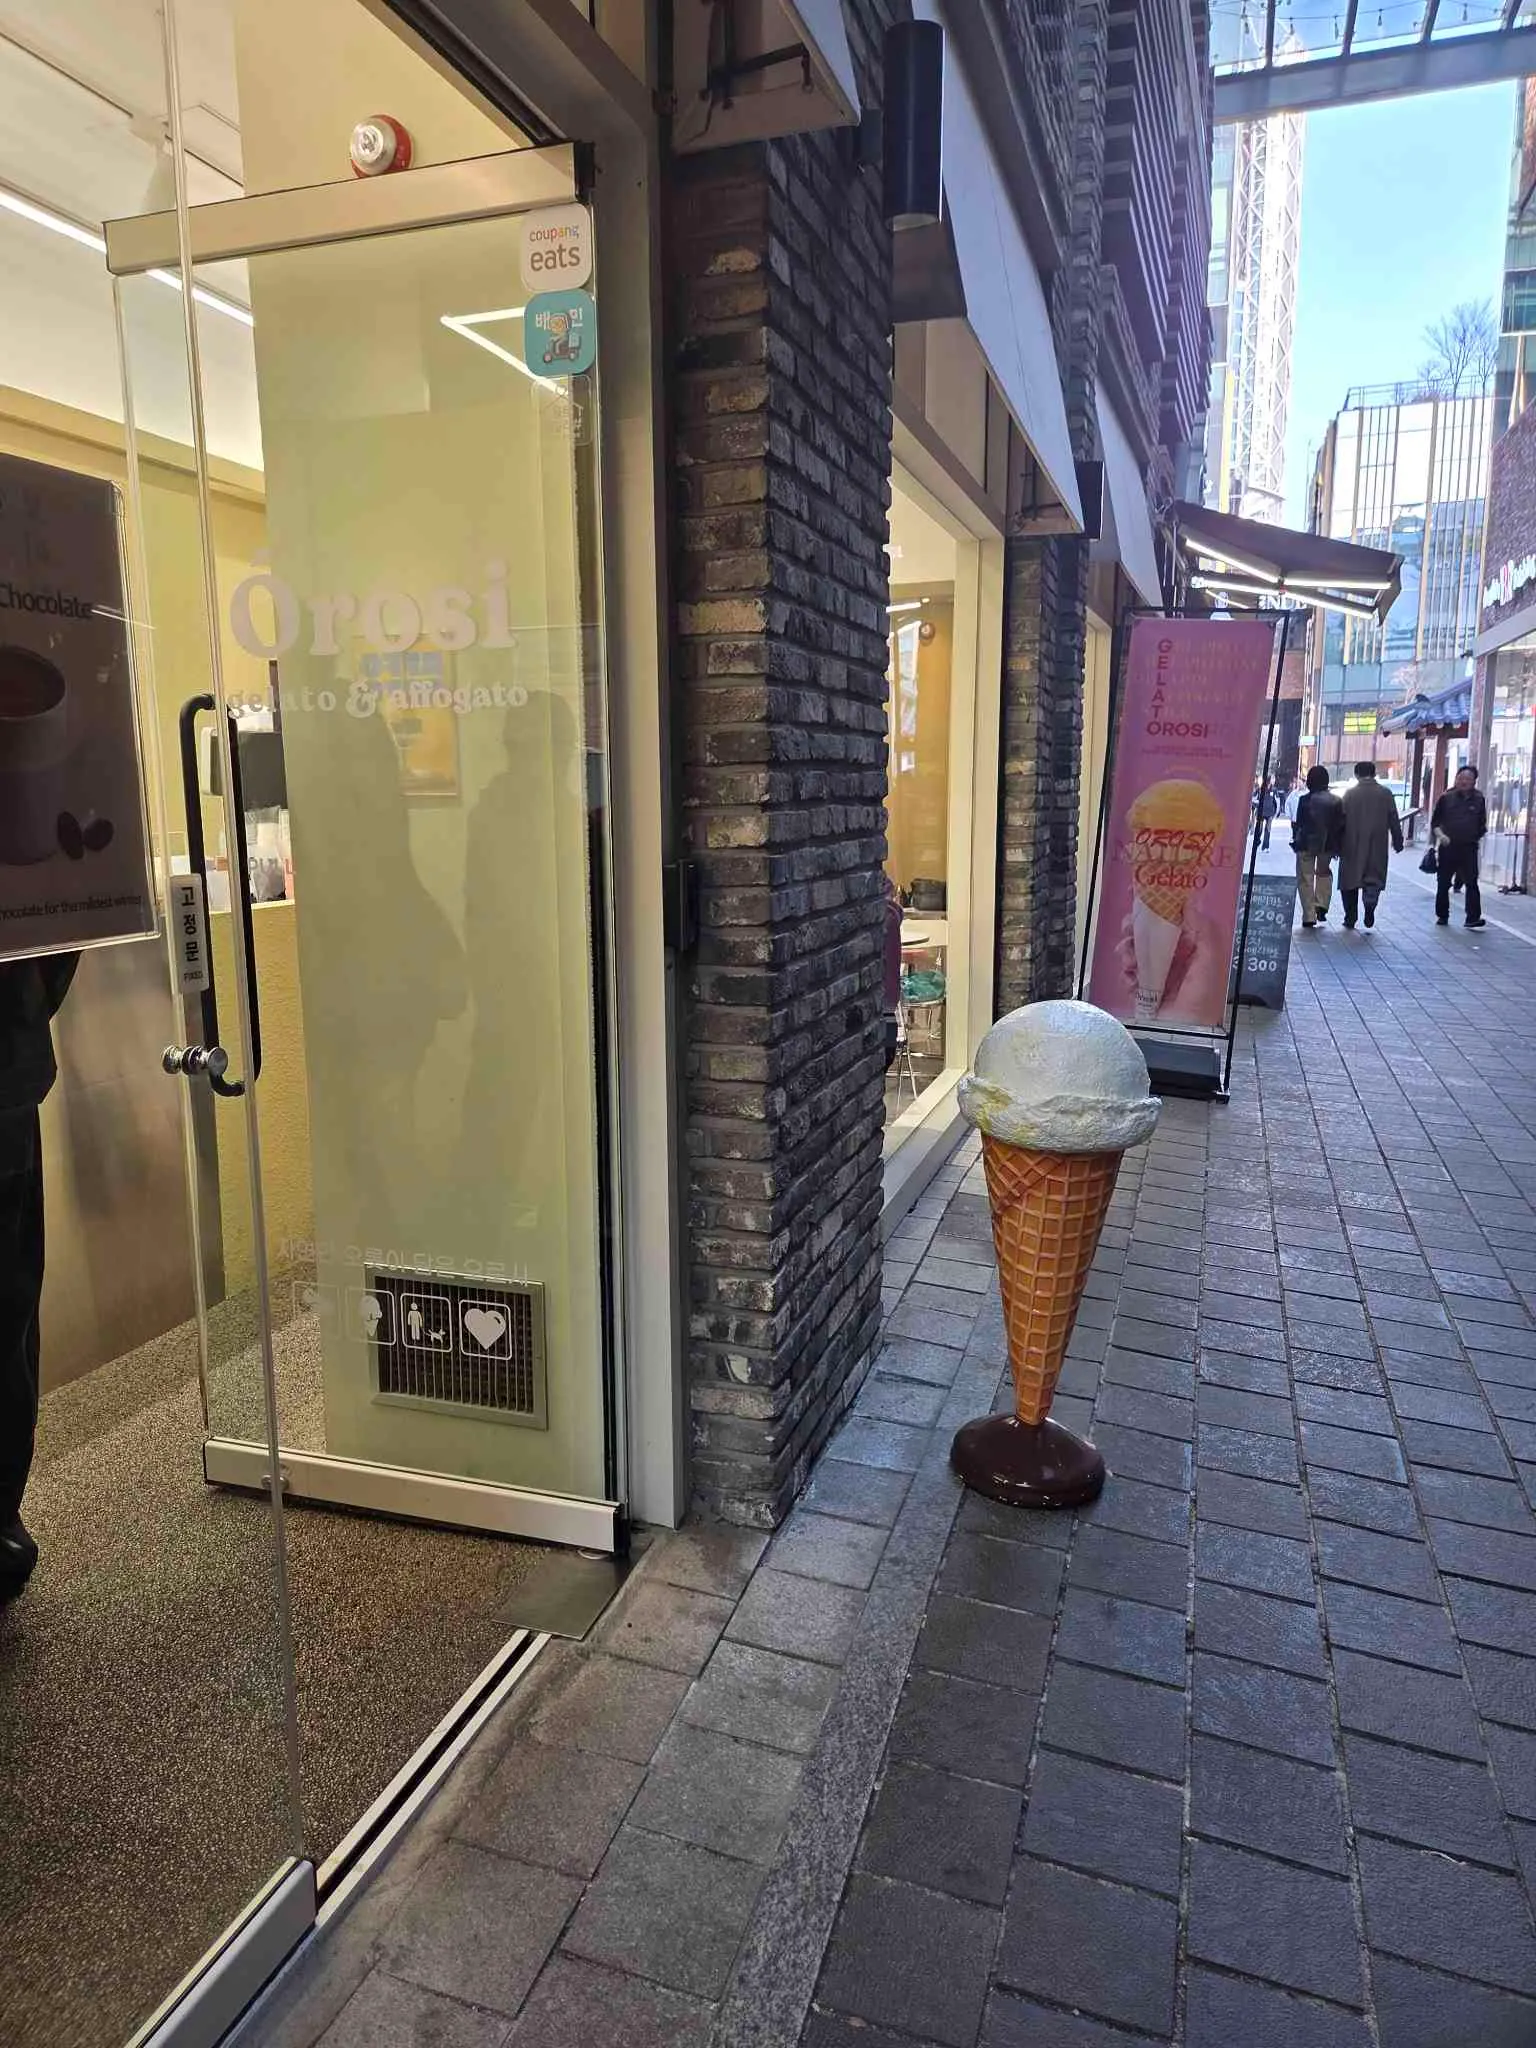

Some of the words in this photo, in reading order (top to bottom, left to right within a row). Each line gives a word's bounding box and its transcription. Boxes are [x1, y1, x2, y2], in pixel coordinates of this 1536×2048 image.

[529, 225, 580, 243] coupang
[530, 243, 581, 272] eats
[346, 678, 378, 718] &
[389, 680, 529, 715] affogato
[1146, 720, 1209, 739] OROSI
[1135, 863, 1208, 889] Gelato
[181, 886, 199, 962] 고정문
